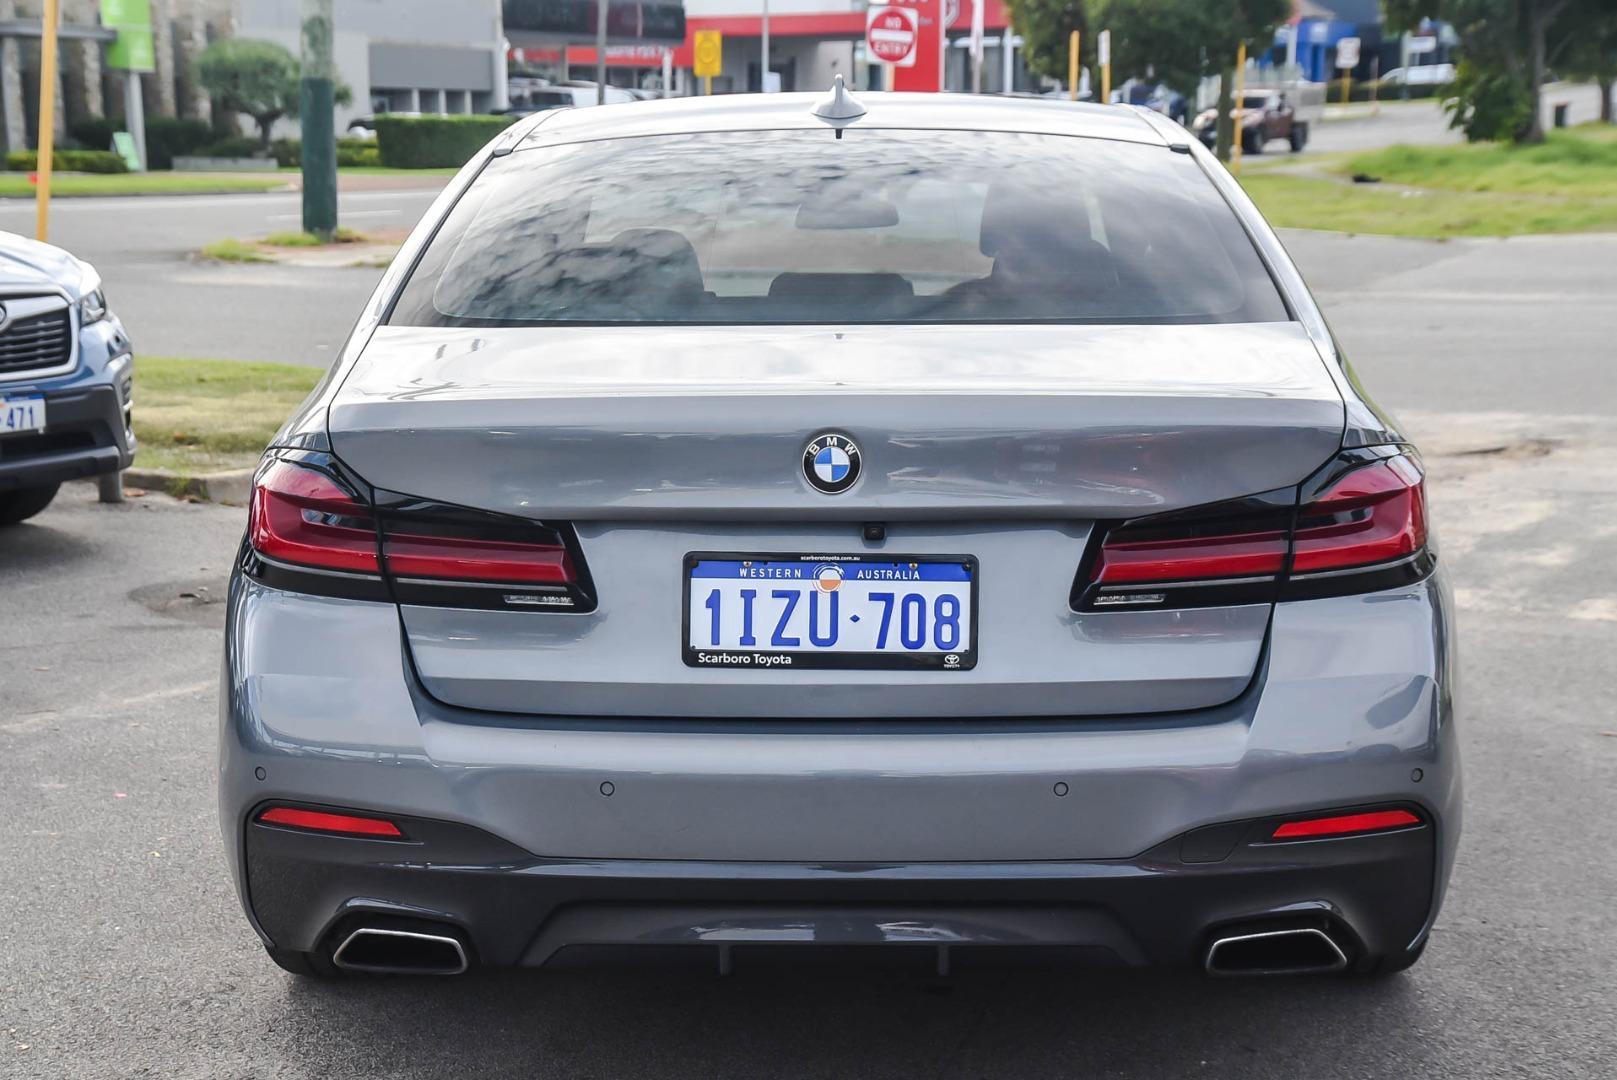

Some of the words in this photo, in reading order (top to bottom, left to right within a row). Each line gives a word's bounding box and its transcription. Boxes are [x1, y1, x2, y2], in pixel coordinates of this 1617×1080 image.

[884, 16, 902, 29] NO
[873, 42, 911, 56] ENTRY
[7, 404, 34, 428] 471
[808, 437, 856, 455] BMW
[739, 568, 802, 578] WESTERN
[857, 569, 921, 580] AUSTRALIA
[697, 652, 751, 664] Scarboro
[753, 653, 792, 667] Toyota
